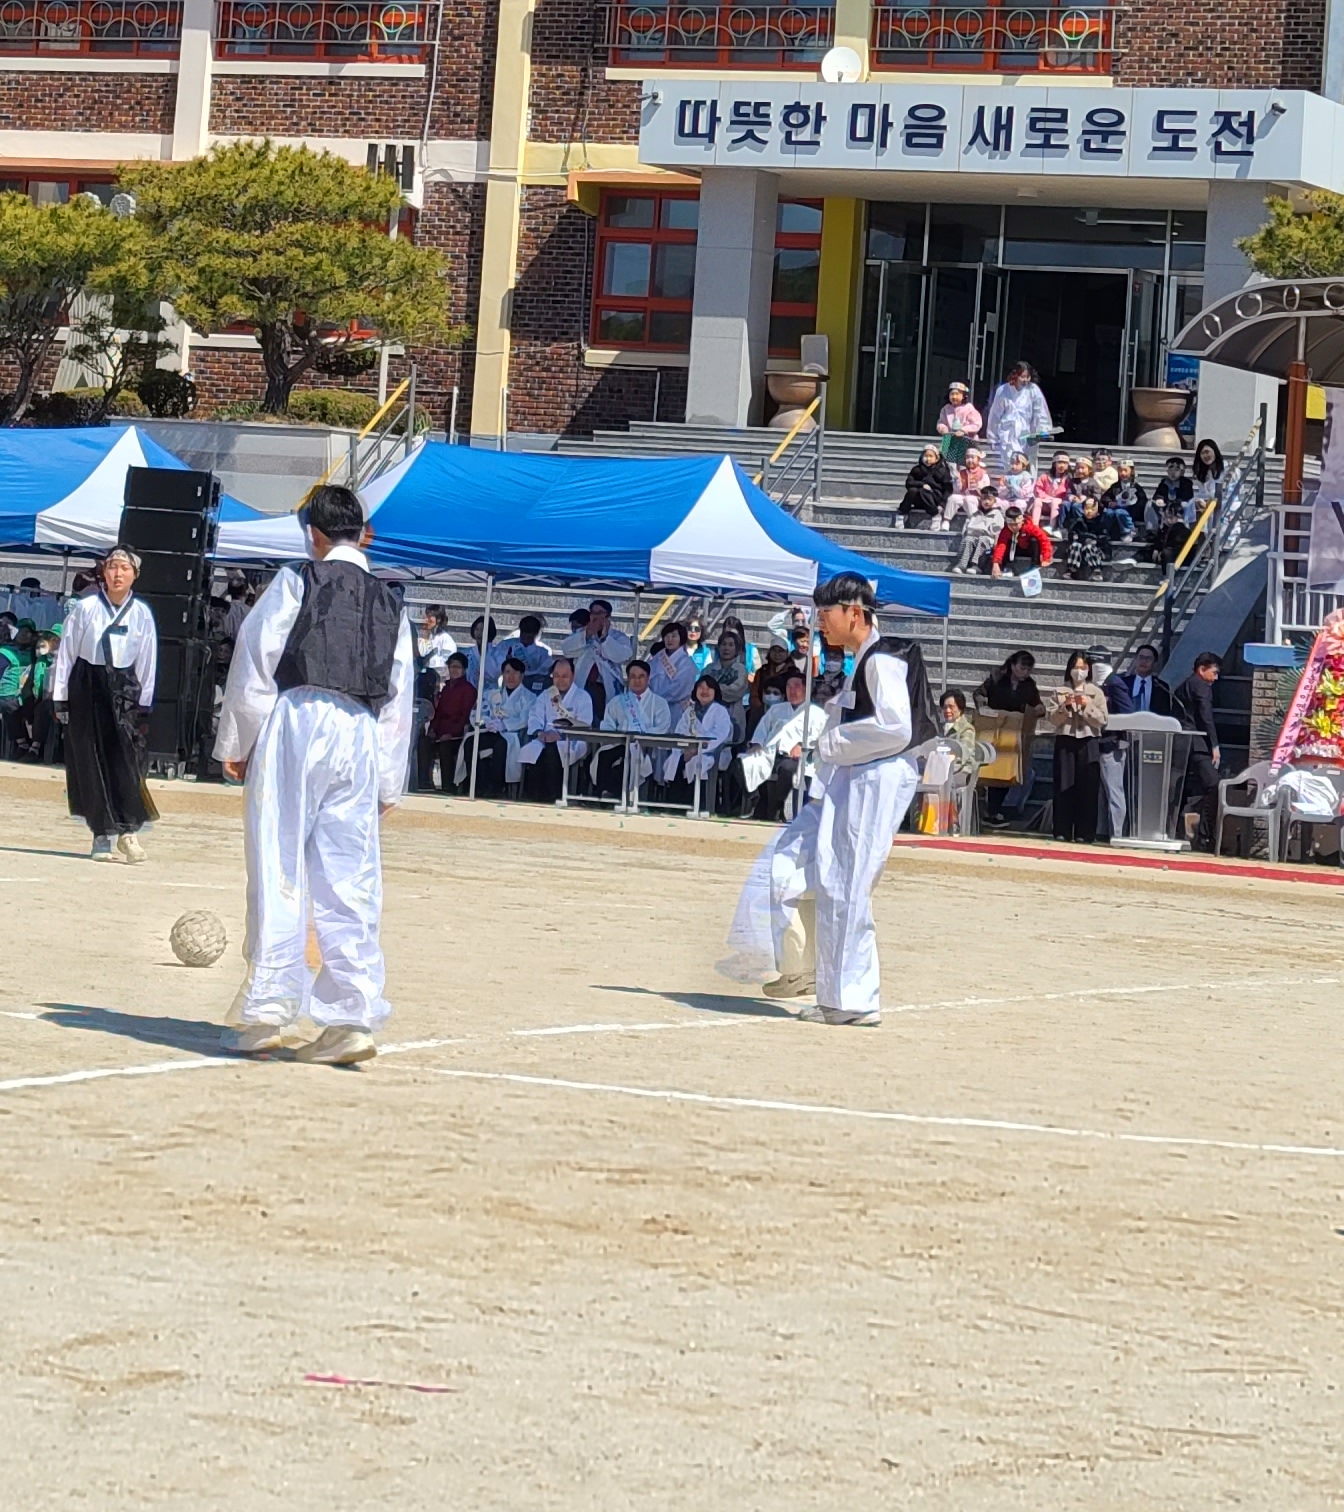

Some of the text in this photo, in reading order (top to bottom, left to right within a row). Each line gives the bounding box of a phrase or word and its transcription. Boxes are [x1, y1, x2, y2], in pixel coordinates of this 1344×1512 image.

[677, 98, 1258, 157] 따뜻한 마음 새로운 도전
